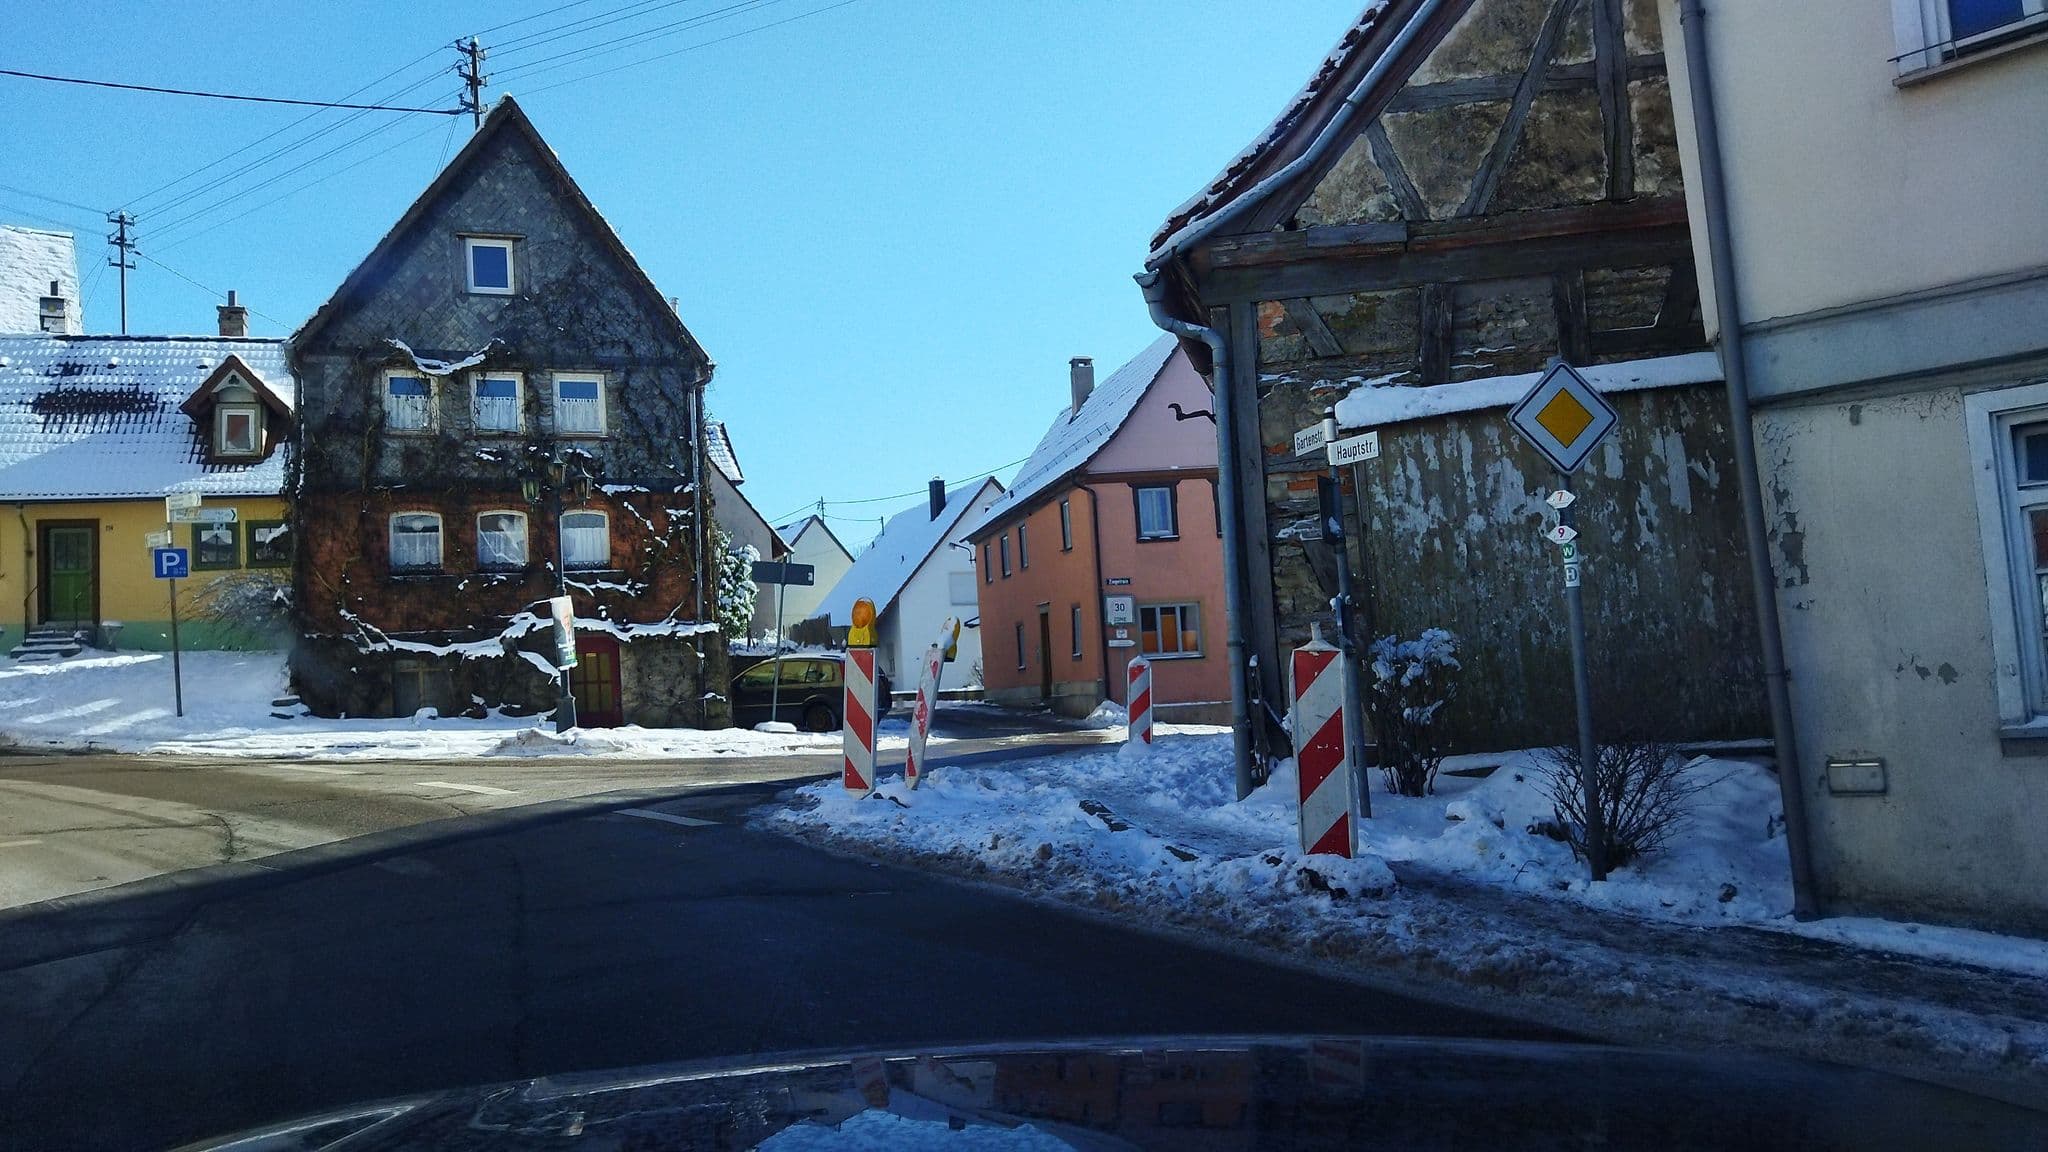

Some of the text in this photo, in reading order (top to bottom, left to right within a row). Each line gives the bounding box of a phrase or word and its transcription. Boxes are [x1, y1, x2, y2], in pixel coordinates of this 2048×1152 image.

[1296, 429, 1325, 451] Gartenstr.
[1336, 439, 1376, 460] Hauptstr.
[1557, 491, 1564, 501] 7
[1558, 527, 1565, 538] 9
[1562, 546, 1574, 557] W
[162, 552, 180, 575] P
[1566, 568, 1575, 580] H
[1114, 603, 1126, 612] 30
